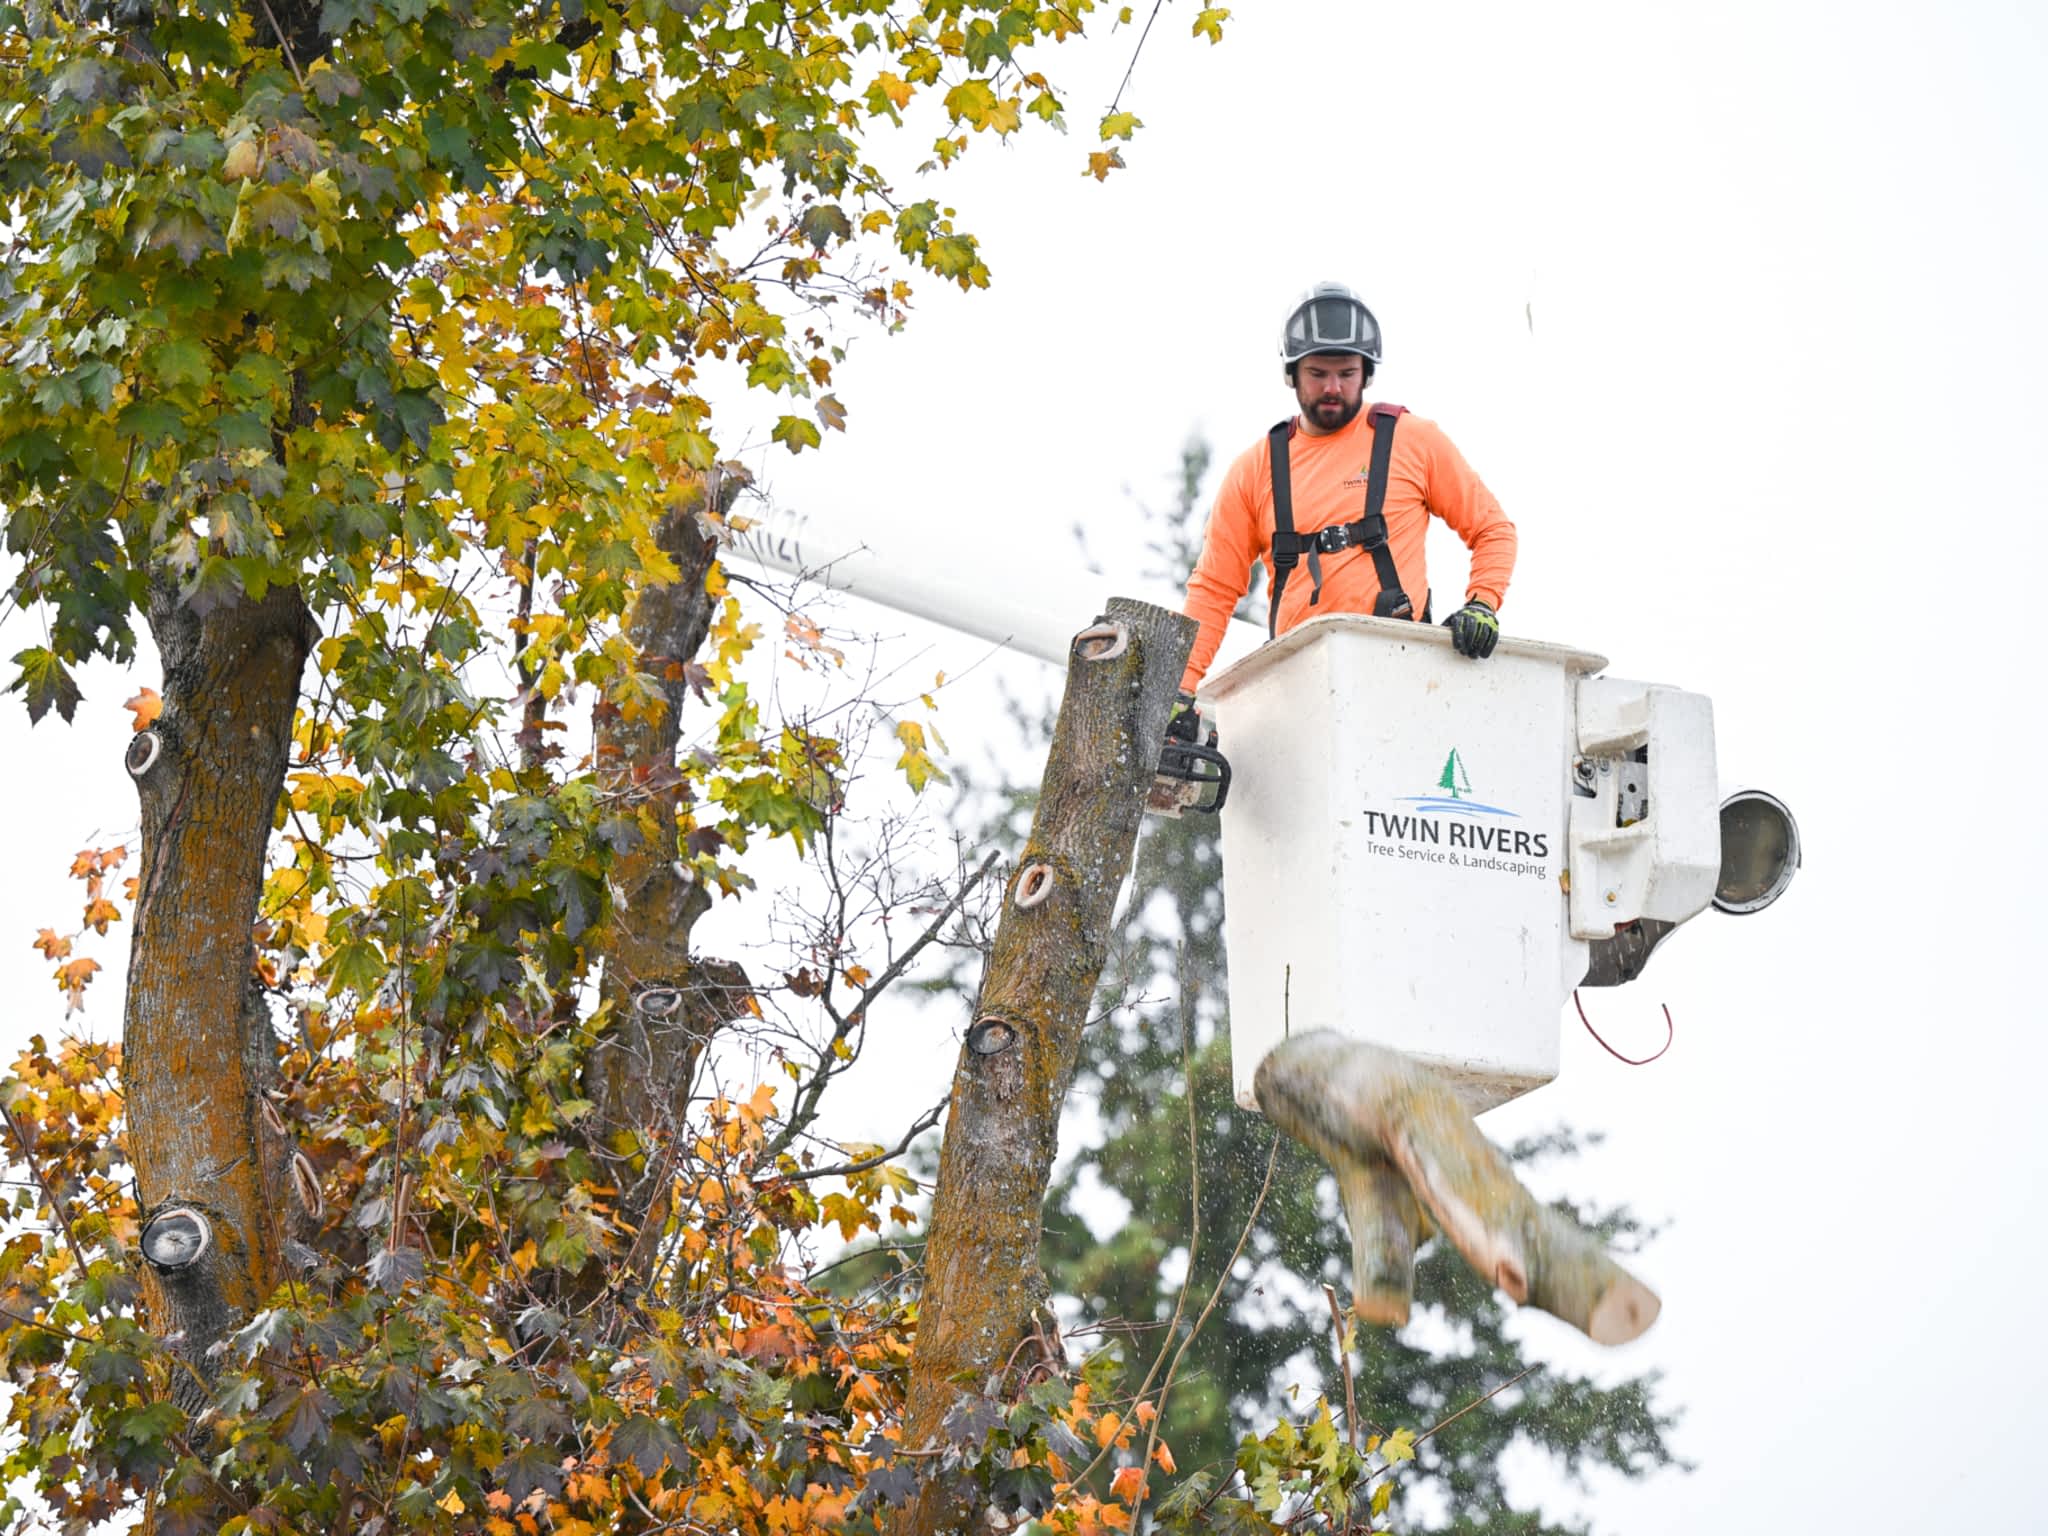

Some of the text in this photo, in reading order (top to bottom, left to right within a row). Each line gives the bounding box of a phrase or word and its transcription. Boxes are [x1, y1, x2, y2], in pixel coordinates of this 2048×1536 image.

[1363, 810, 1549, 858] TWIN RIVERS
[1367, 841, 1547, 880] Tree Service & Landscaping
